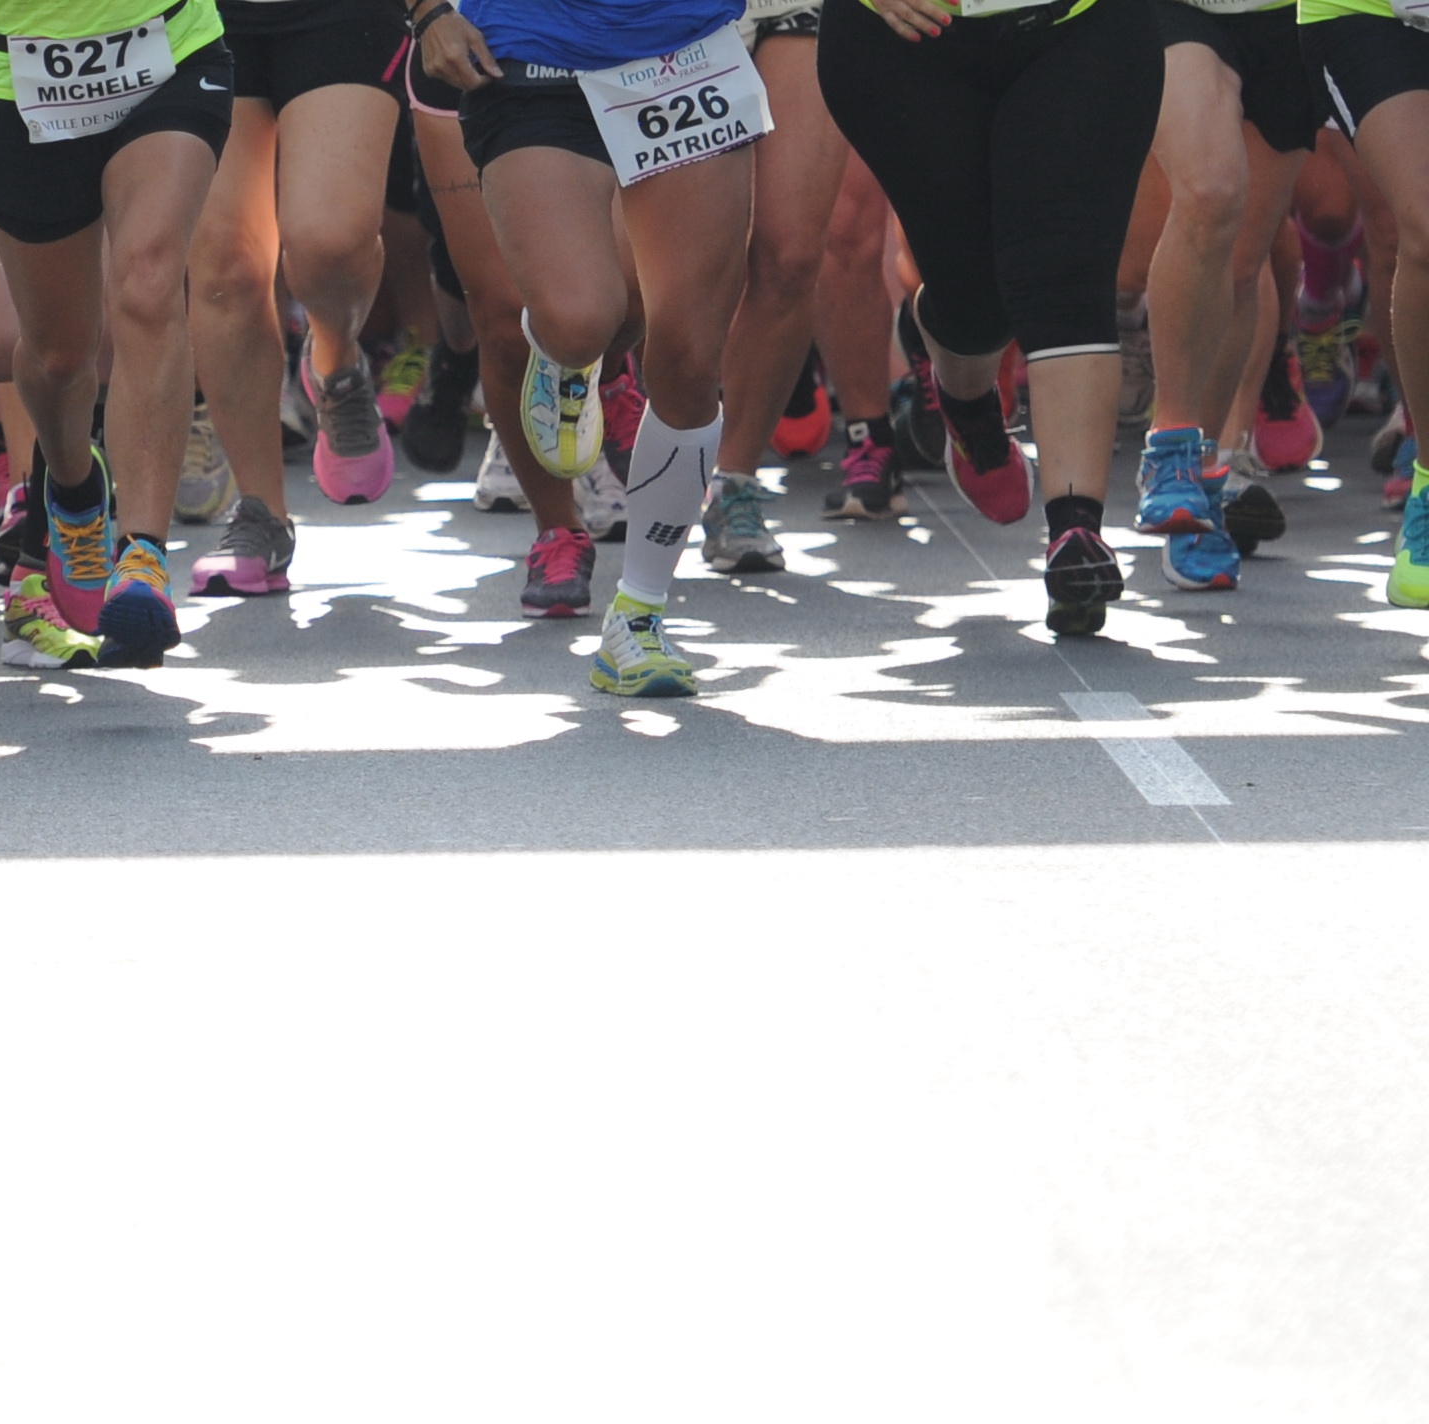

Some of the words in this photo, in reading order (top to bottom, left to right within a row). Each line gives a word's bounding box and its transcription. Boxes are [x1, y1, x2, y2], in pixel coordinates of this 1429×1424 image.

[43, 30, 133, 79] 627
[619, 67, 657, 88] Iron
[675, 43, 707, 67] Girl
[653, 76, 670, 88] RUN
[679, 61, 710, 79] FRANCE
[37, 69, 154, 102] MICHELE
[41, 116, 78, 131] VILLE
[82, 113, 101, 127] DE
[637, 85, 730, 140] 626
[635, 119, 749, 170] PATRICIA
